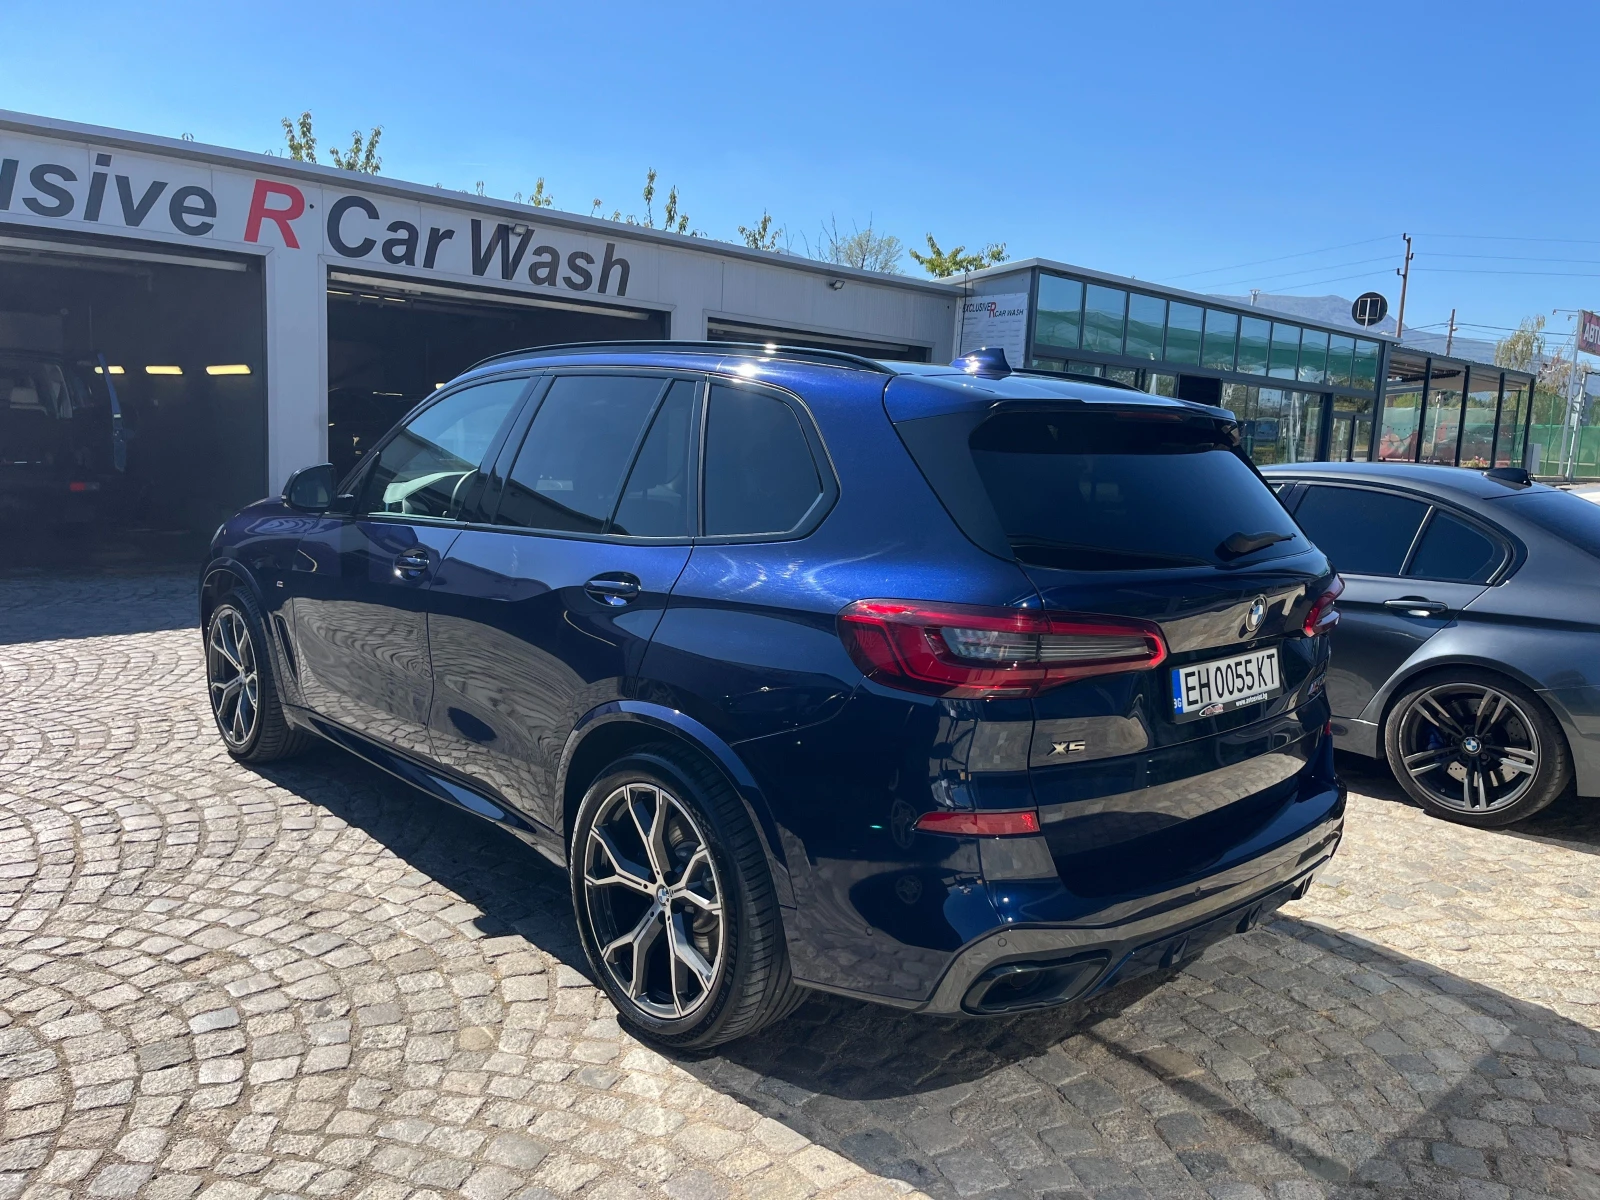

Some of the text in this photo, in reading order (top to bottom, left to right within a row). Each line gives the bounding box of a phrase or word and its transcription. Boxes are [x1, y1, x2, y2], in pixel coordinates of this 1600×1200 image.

[244, 179, 305, 249] R
[327, 195, 456, 269] Car
[471, 218, 631, 296] Wash
[988, 302, 997, 318] R
[995, 310, 1006, 318] CAR
[1047, 740, 1086, 757] X5
